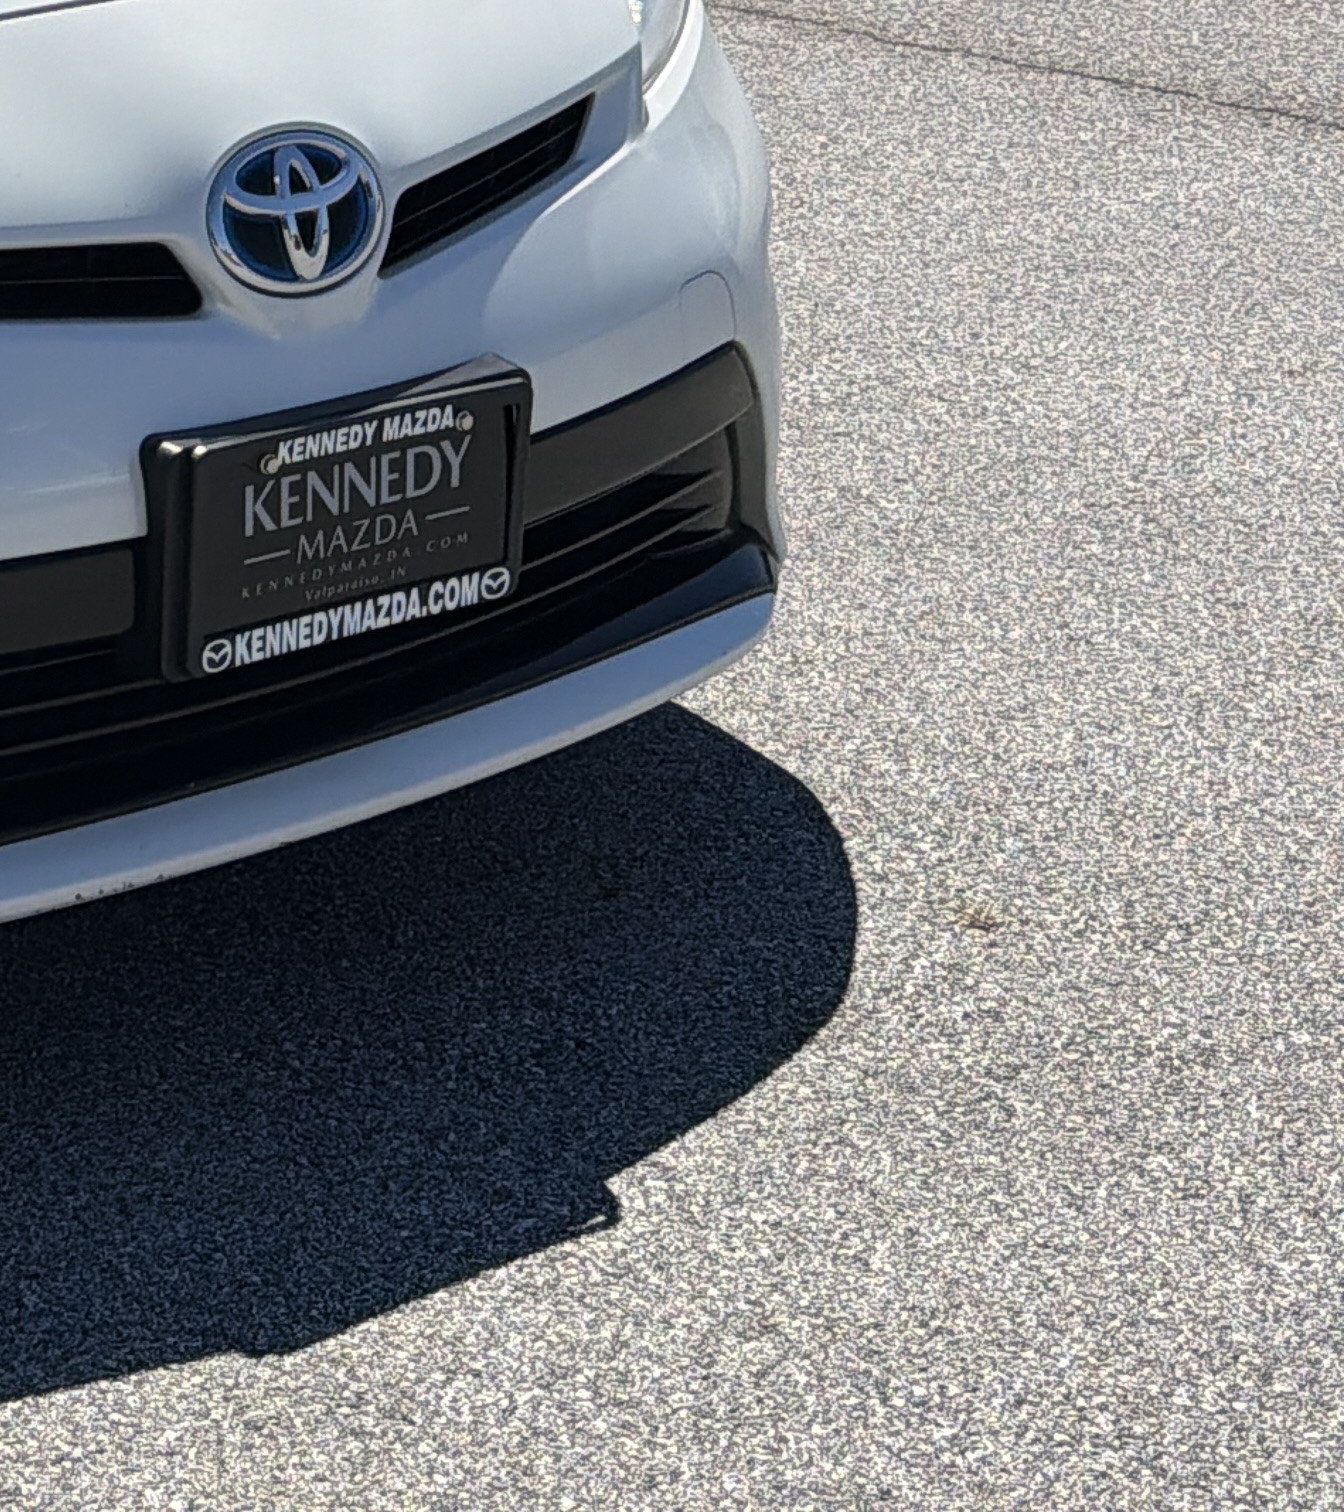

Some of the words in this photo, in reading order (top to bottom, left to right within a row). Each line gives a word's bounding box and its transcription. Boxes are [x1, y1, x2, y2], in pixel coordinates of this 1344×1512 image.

[277, 420, 378, 465] KENNEDY
[382, 403, 456, 439] MAZDA
[244, 435, 471, 537] KENNEDY
[241, 531, 470, 599] KENNEDYMAZDACOM
[296, 509, 419, 565] MAZDA
[234, 571, 481, 667] KENNEDYMAZDA.COM
